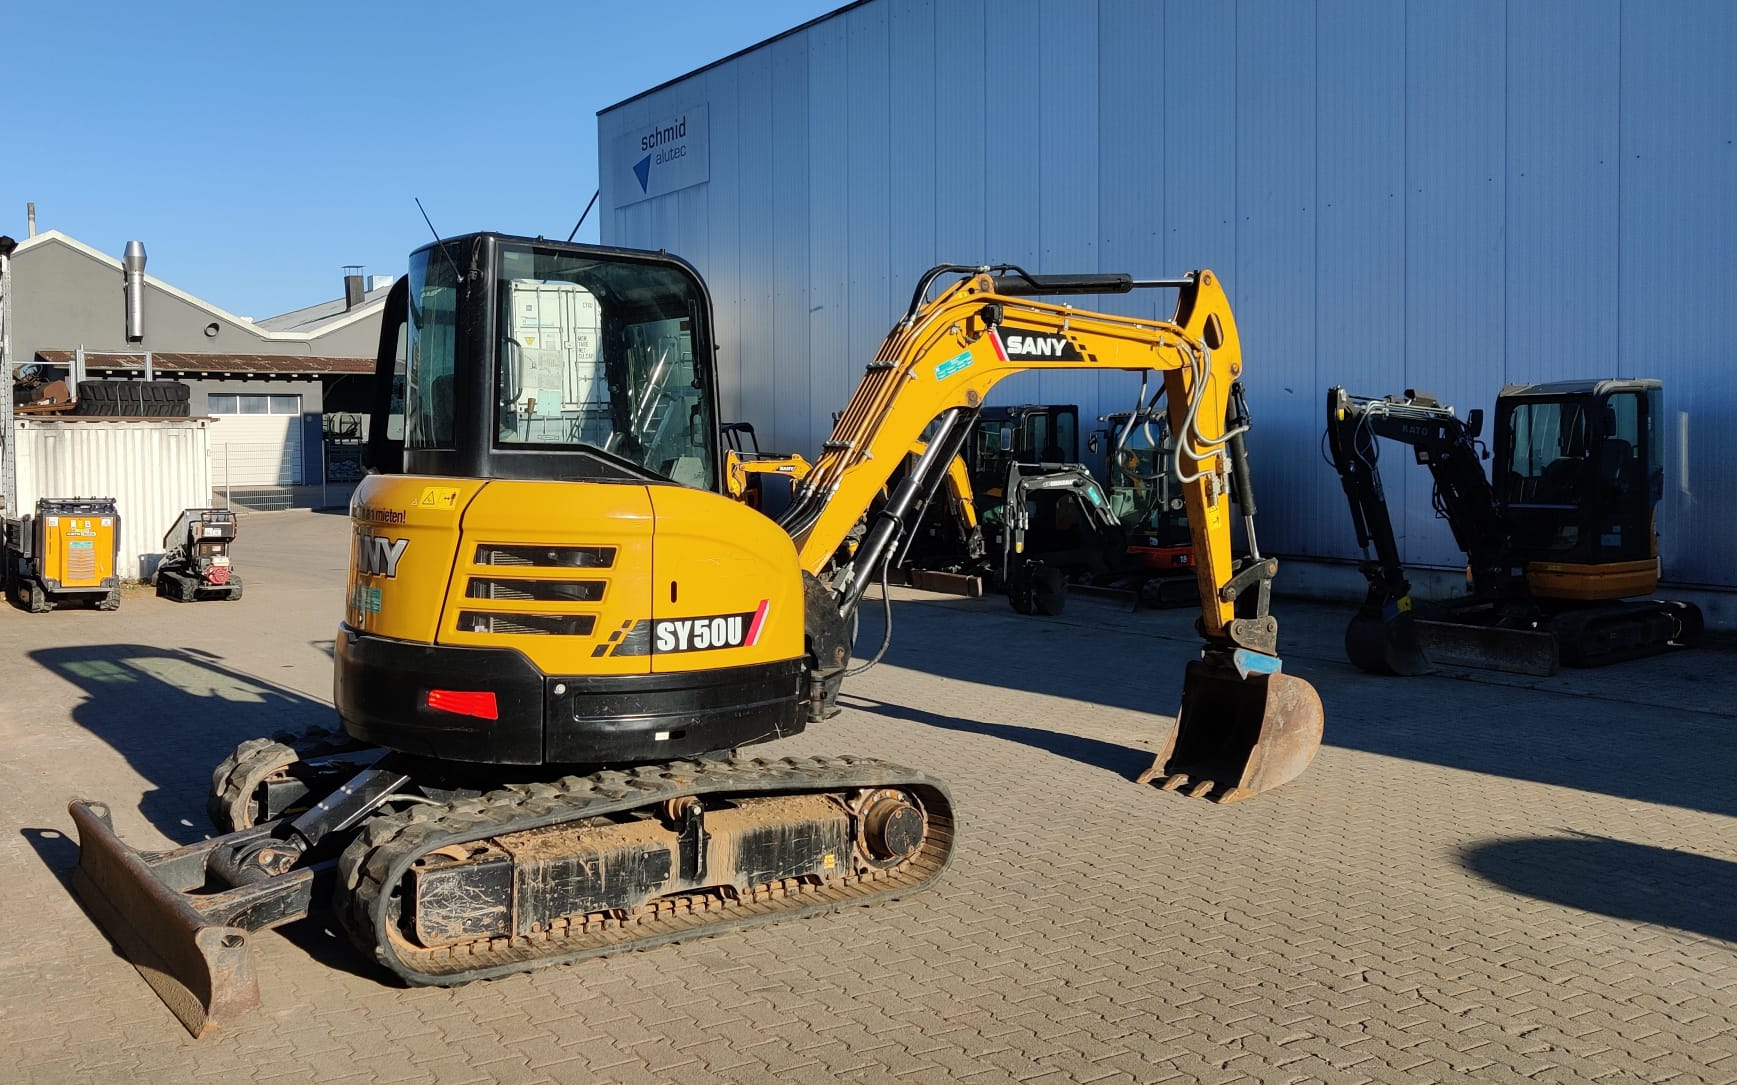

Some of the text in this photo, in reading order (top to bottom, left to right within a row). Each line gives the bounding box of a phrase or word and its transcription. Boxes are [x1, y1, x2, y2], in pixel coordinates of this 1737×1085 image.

[642, 116, 686, 151] schmid
[656, 146, 686, 165] alutec
[1006, 336, 1067, 357] SANY
[1402, 424, 1428, 436] KATO
[375, 507, 406, 524] mieten!
[656, 616, 742, 651] SY50U
